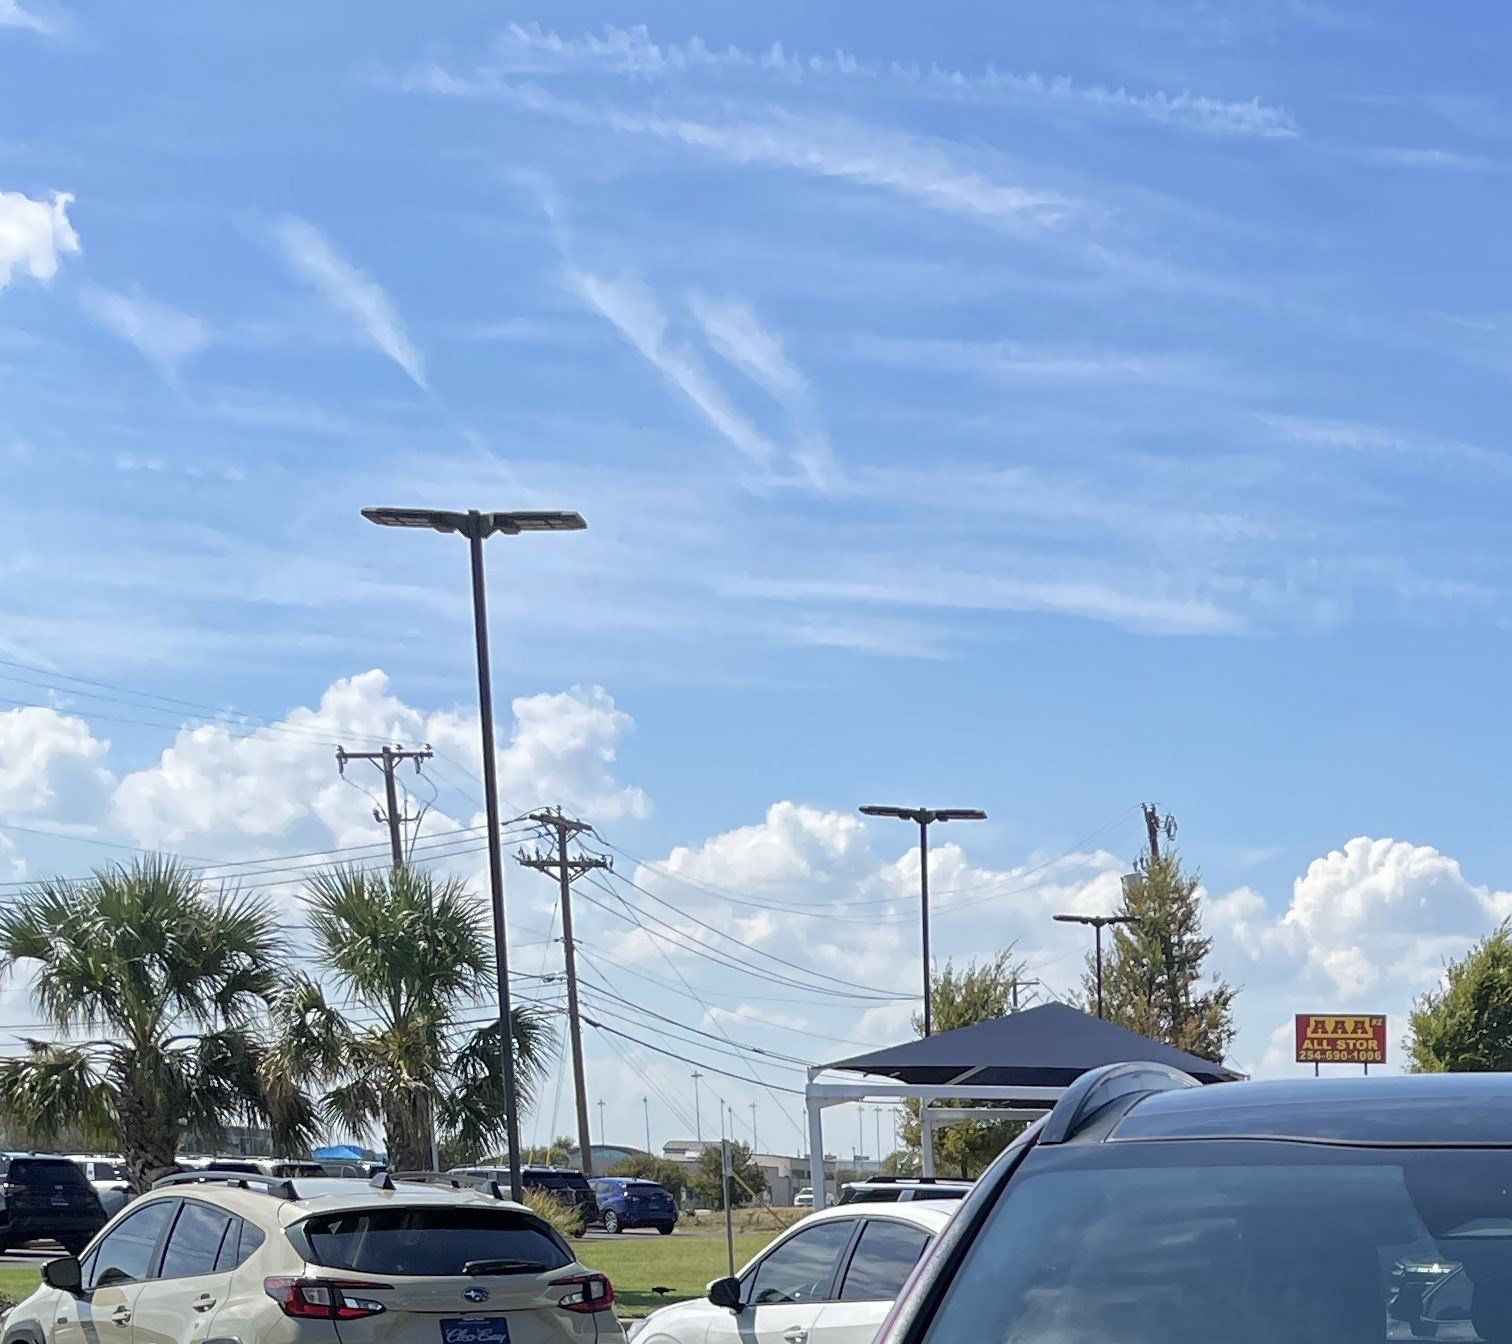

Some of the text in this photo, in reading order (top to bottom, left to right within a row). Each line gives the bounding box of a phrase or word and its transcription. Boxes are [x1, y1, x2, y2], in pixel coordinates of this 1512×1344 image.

[1310, 1019, 1369, 1035] AAA
[1302, 1040, 1379, 1050] ALL STOR
